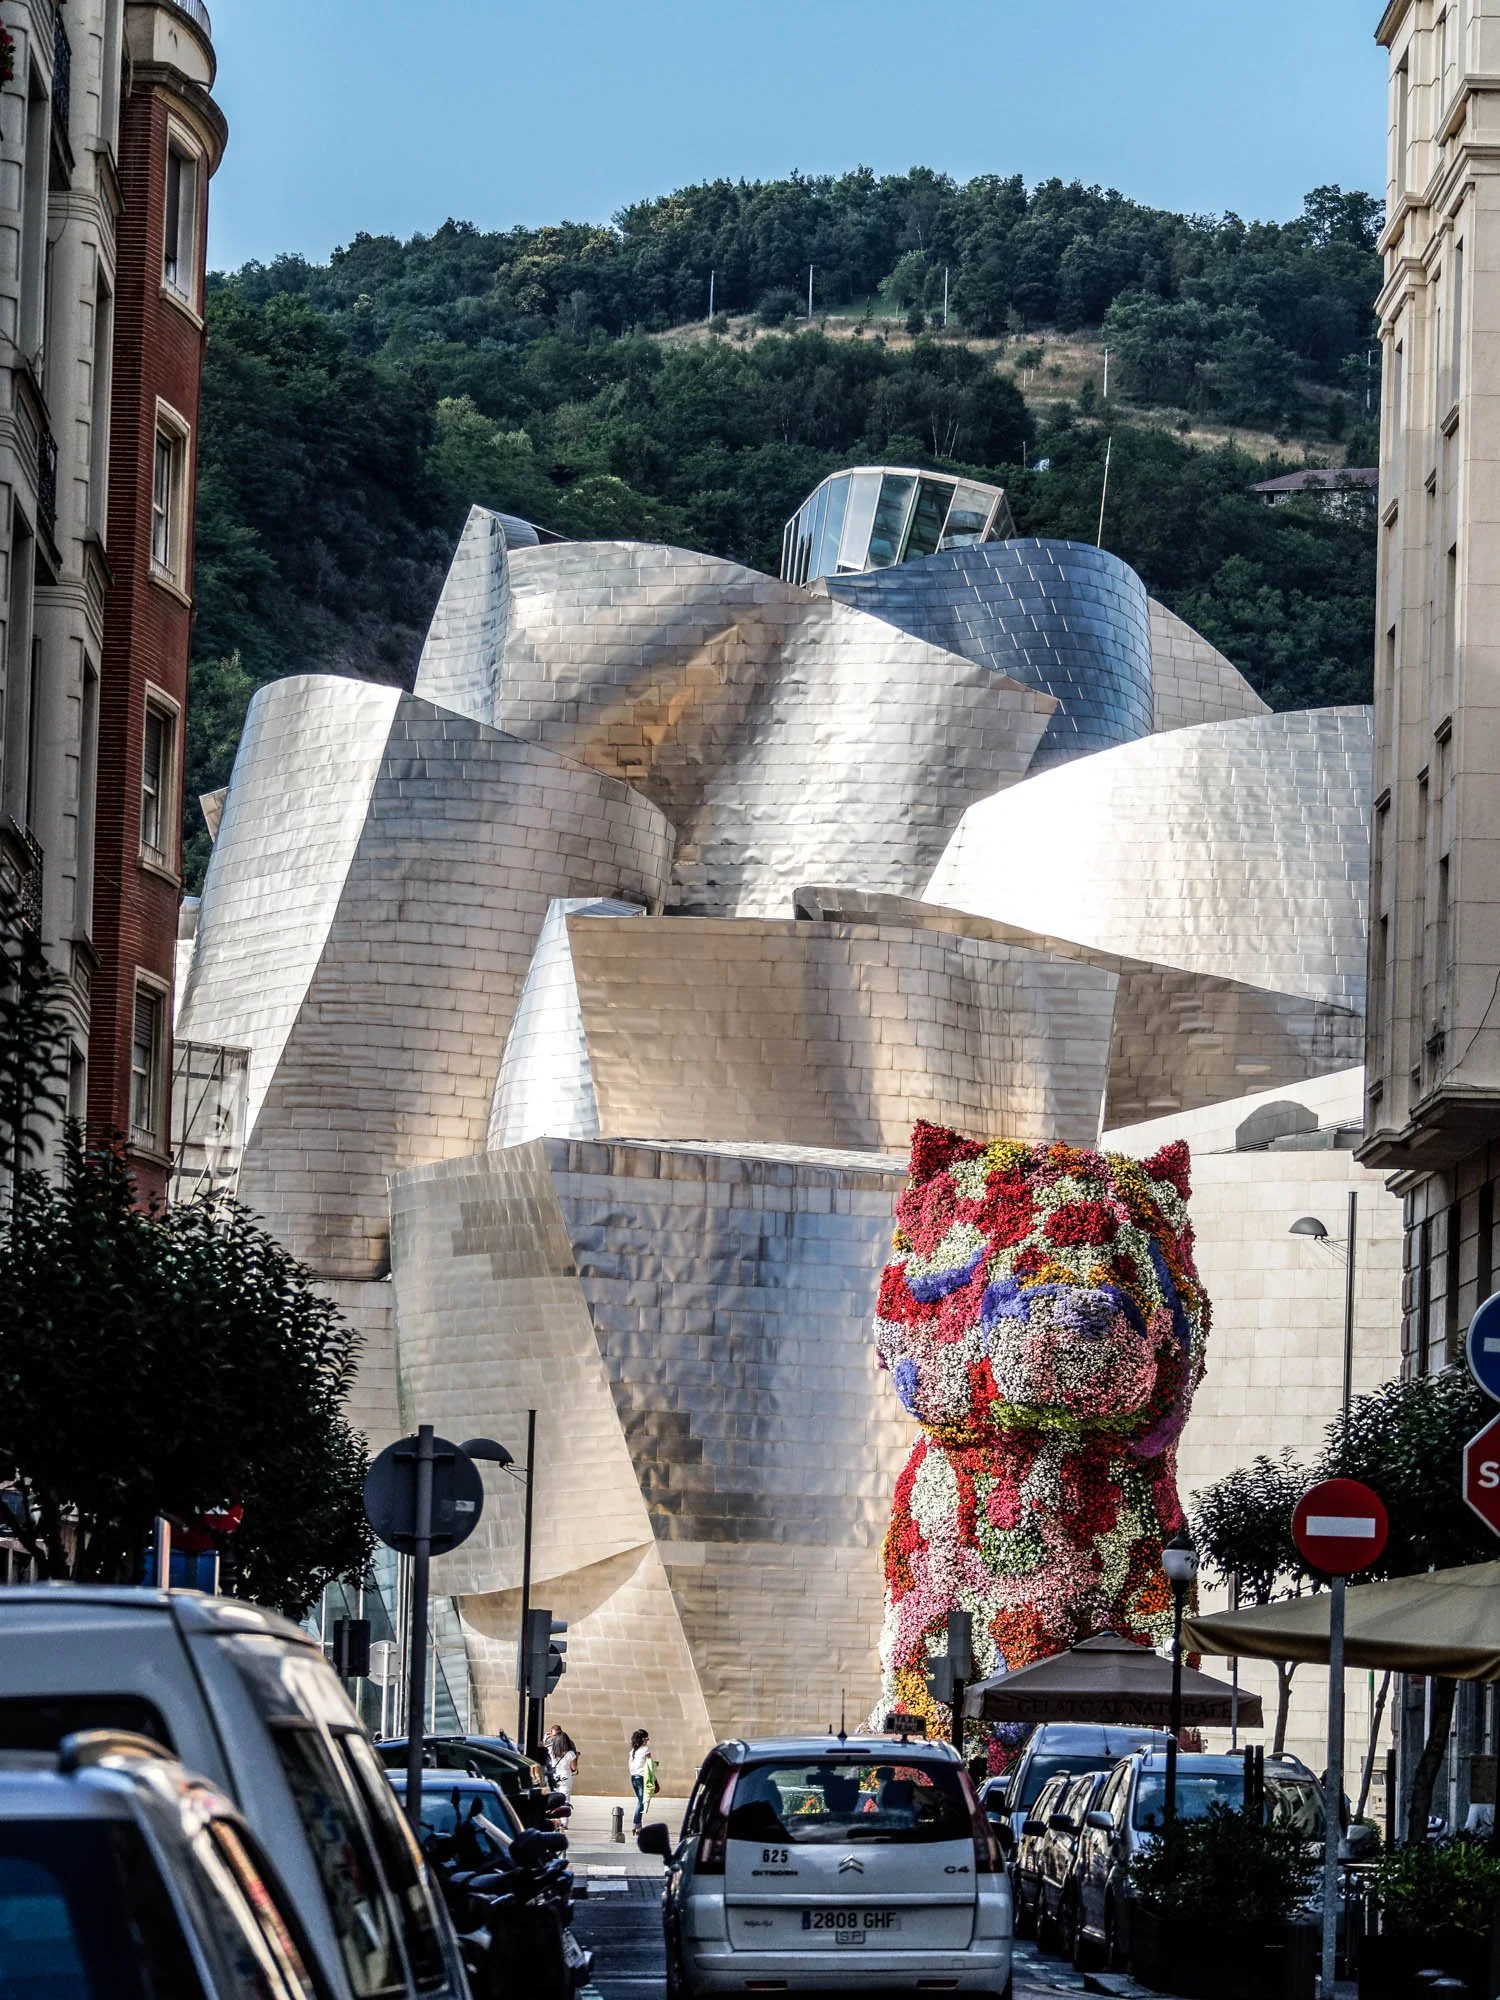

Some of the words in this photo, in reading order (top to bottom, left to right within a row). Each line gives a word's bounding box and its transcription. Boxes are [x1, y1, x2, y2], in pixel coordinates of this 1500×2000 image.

[762, 1849, 789, 1863] 625
[943, 1866, 969, 1874] C4
[813, 1911, 858, 1929] 2808
[863, 1911, 897, 1929] GHF
